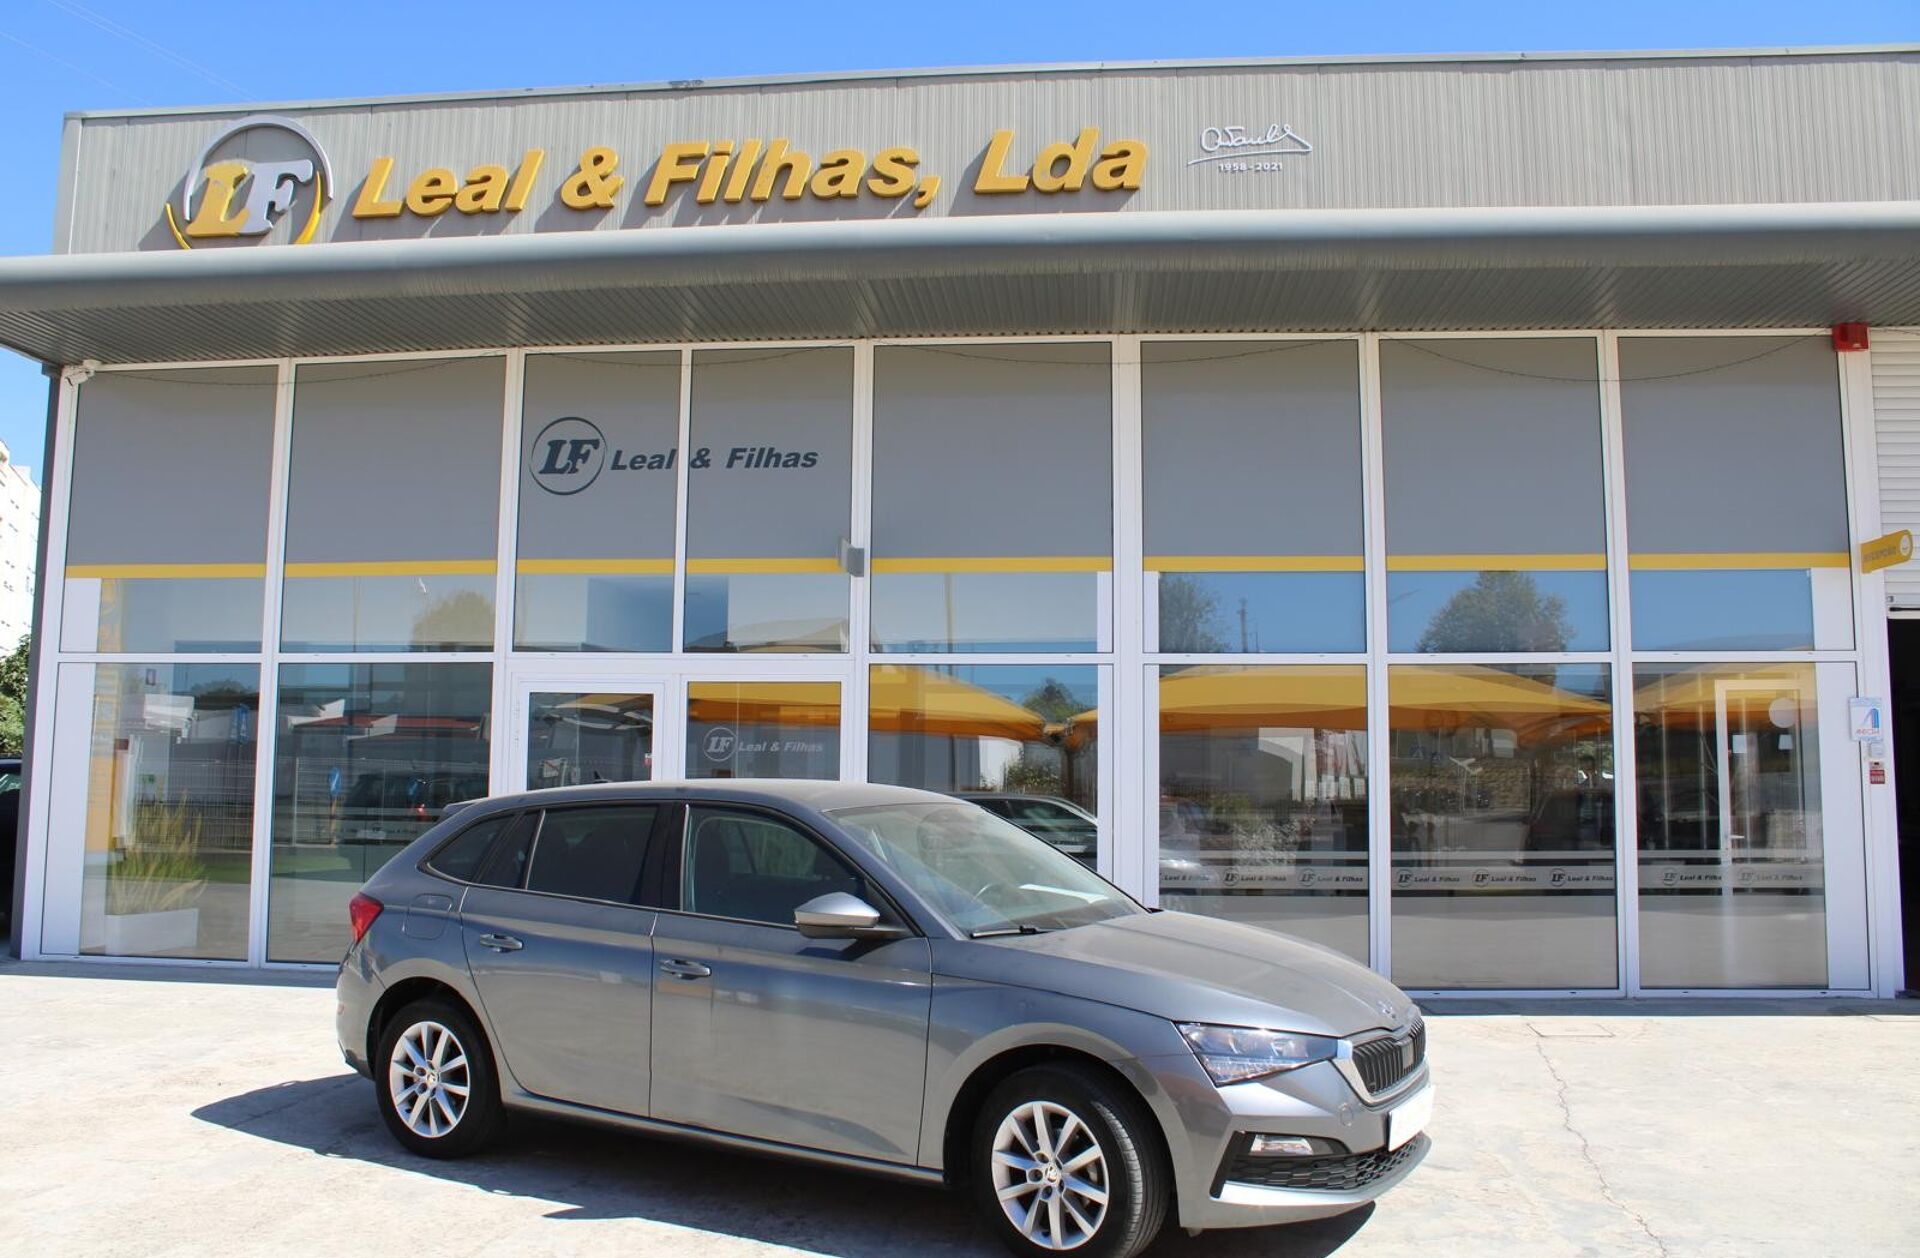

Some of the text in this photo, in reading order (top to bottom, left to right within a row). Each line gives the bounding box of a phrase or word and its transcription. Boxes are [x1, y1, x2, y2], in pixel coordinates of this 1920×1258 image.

[351, 147, 545, 220] Leal
[560, 145, 625, 211] &
[644, 137, 941, 209] Filhas,
[973, 126, 1150, 197] Lda
[538, 438, 601, 475] LF
[610, 446, 819, 471] Leal & Filhas
[706, 736, 734, 753] LF
[738, 740, 824, 753] Leal & Filhas
